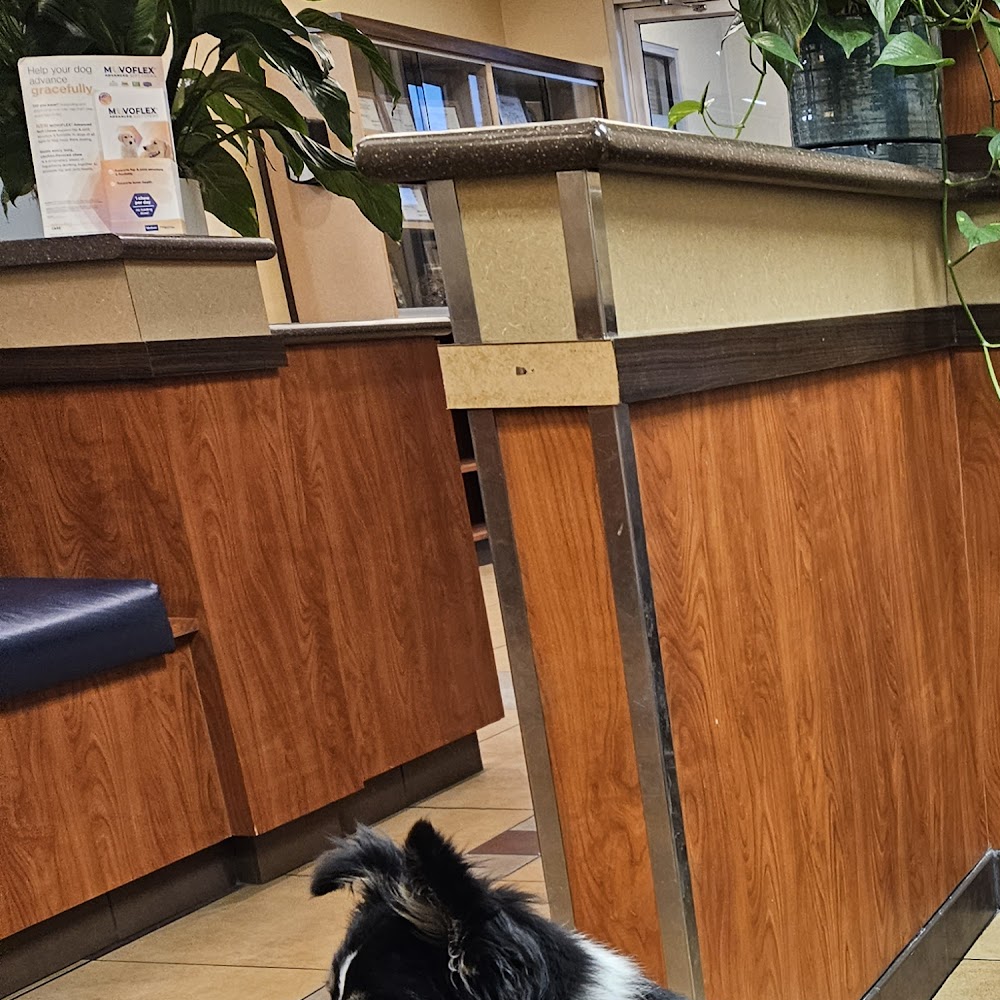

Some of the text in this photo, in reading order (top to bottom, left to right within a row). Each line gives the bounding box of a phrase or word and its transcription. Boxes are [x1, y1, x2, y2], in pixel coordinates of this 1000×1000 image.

[27, 65, 92, 75] Help your dog
[29, 76, 68, 85] advance
[31, 83, 93, 97] gracefully
